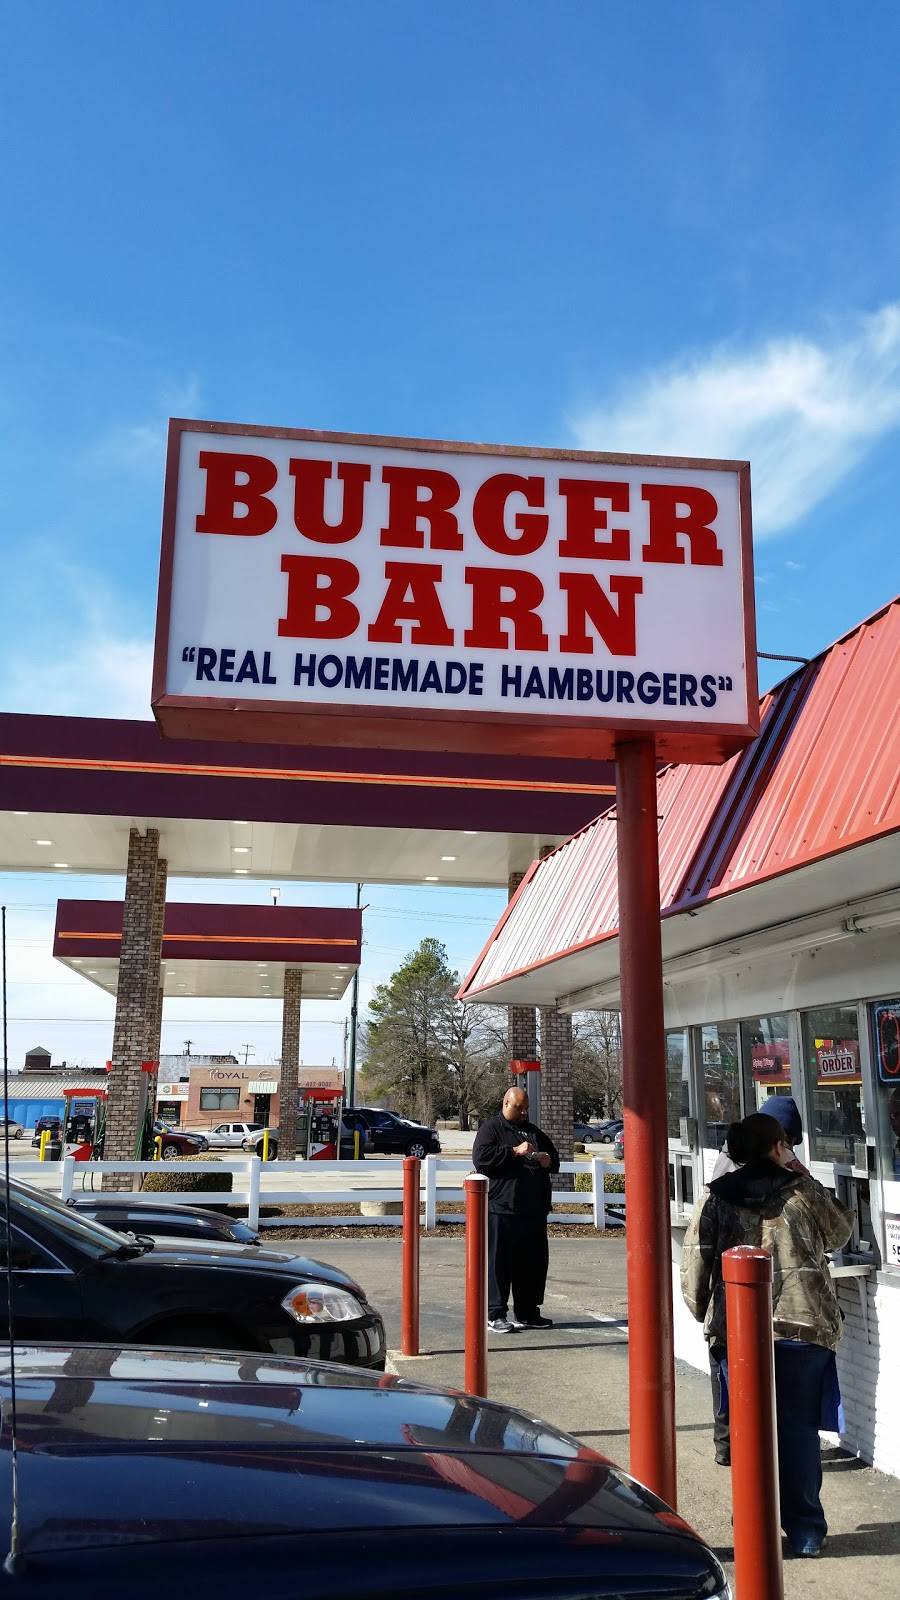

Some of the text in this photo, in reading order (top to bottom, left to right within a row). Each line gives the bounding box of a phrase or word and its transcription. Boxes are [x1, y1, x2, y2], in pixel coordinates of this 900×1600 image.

[195, 450, 724, 567] BURGER
[277, 554, 644, 657] BARN
[181, 646, 733, 708] “REAL HOMEMADE HAMBURGERS”
[822, 1056, 853, 1073] ORDER
